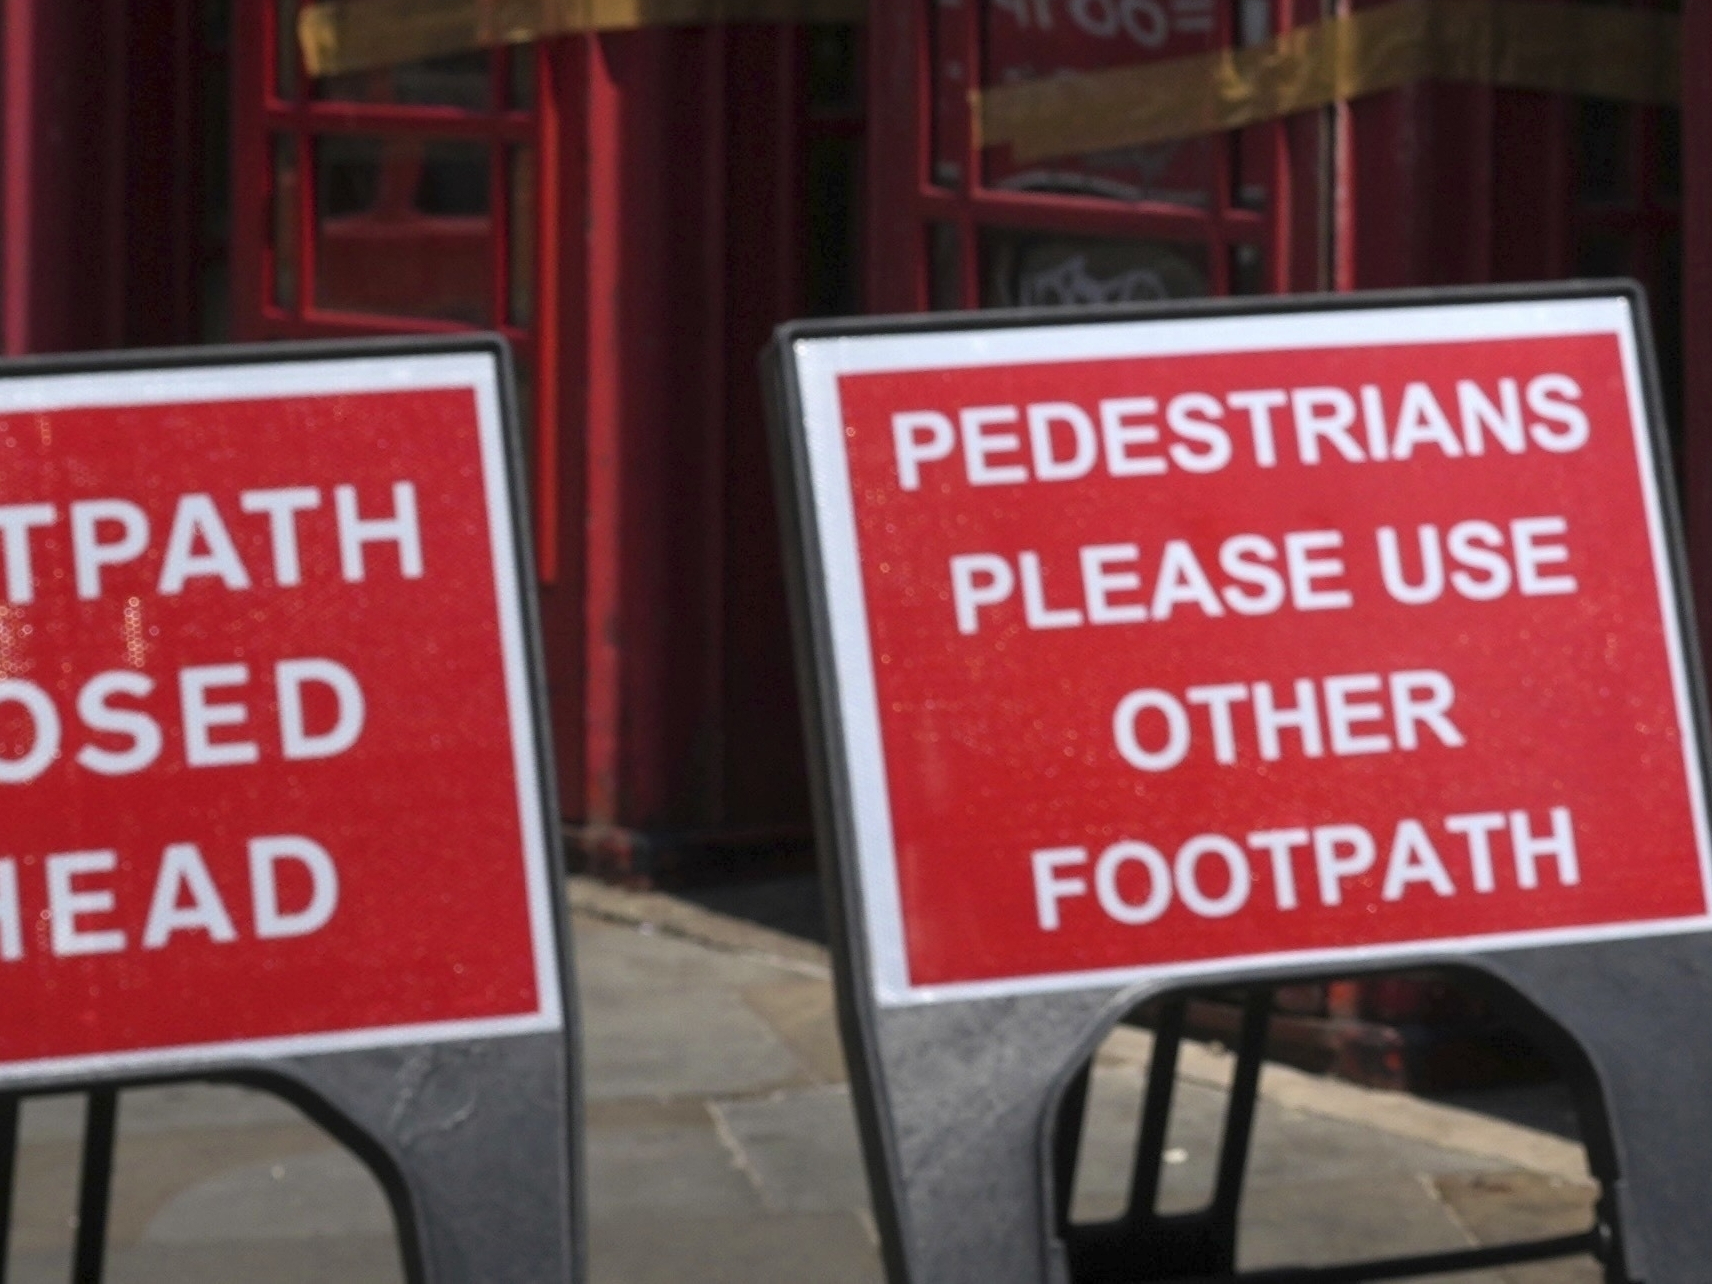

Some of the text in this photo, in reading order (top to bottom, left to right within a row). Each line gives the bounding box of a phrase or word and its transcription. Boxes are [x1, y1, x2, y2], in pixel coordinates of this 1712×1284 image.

[892, 374, 1589, 490] PEDESTRIANS
[0, 482, 422, 603] TPATH
[951, 517, 1577, 633] PLEASE USE
[0, 660, 363, 782] OSED
[1114, 670, 1464, 771] OTHER
[1033, 807, 1579, 929] FOOTPATH
